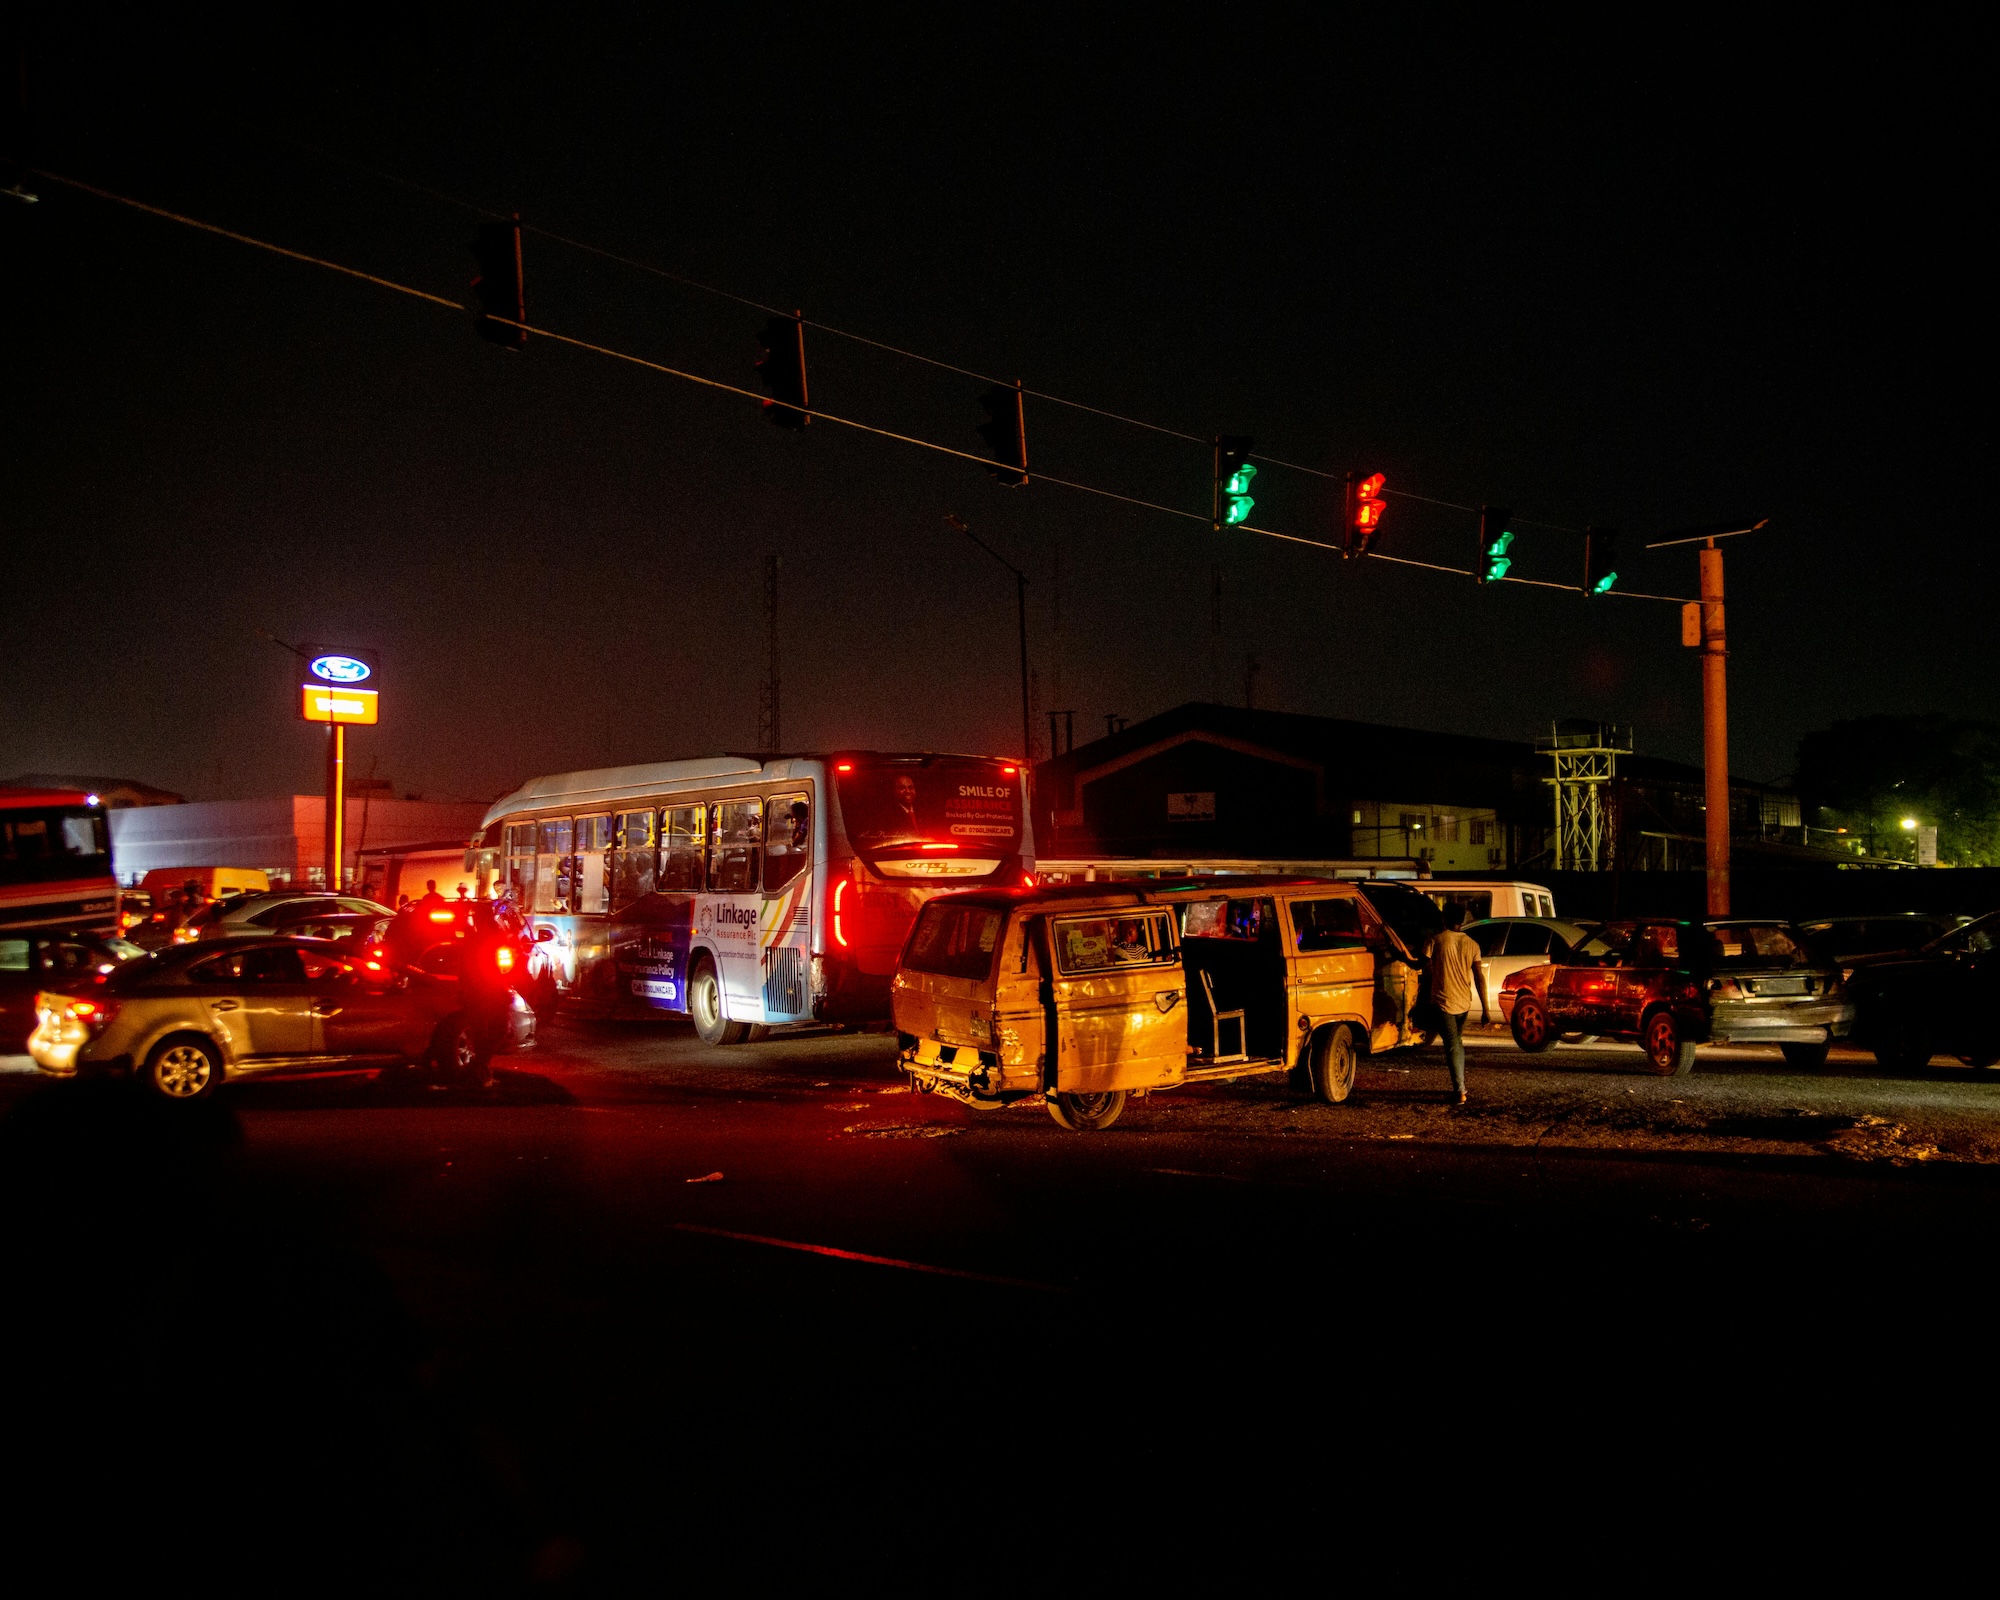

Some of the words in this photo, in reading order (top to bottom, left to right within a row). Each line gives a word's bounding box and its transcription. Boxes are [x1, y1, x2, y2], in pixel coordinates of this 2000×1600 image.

[958, 785, 994, 798] SMILE
[995, 787, 1011, 798] OF
[945, 798, 1012, 811] ASSURANCE
[716, 903, 757, 930] Linkage
[716, 929, 746, 940] Assurance
[747, 930, 757, 940] Plc
[653, 948, 674, 963] Linkage
[658, 963, 675, 979] Policy
